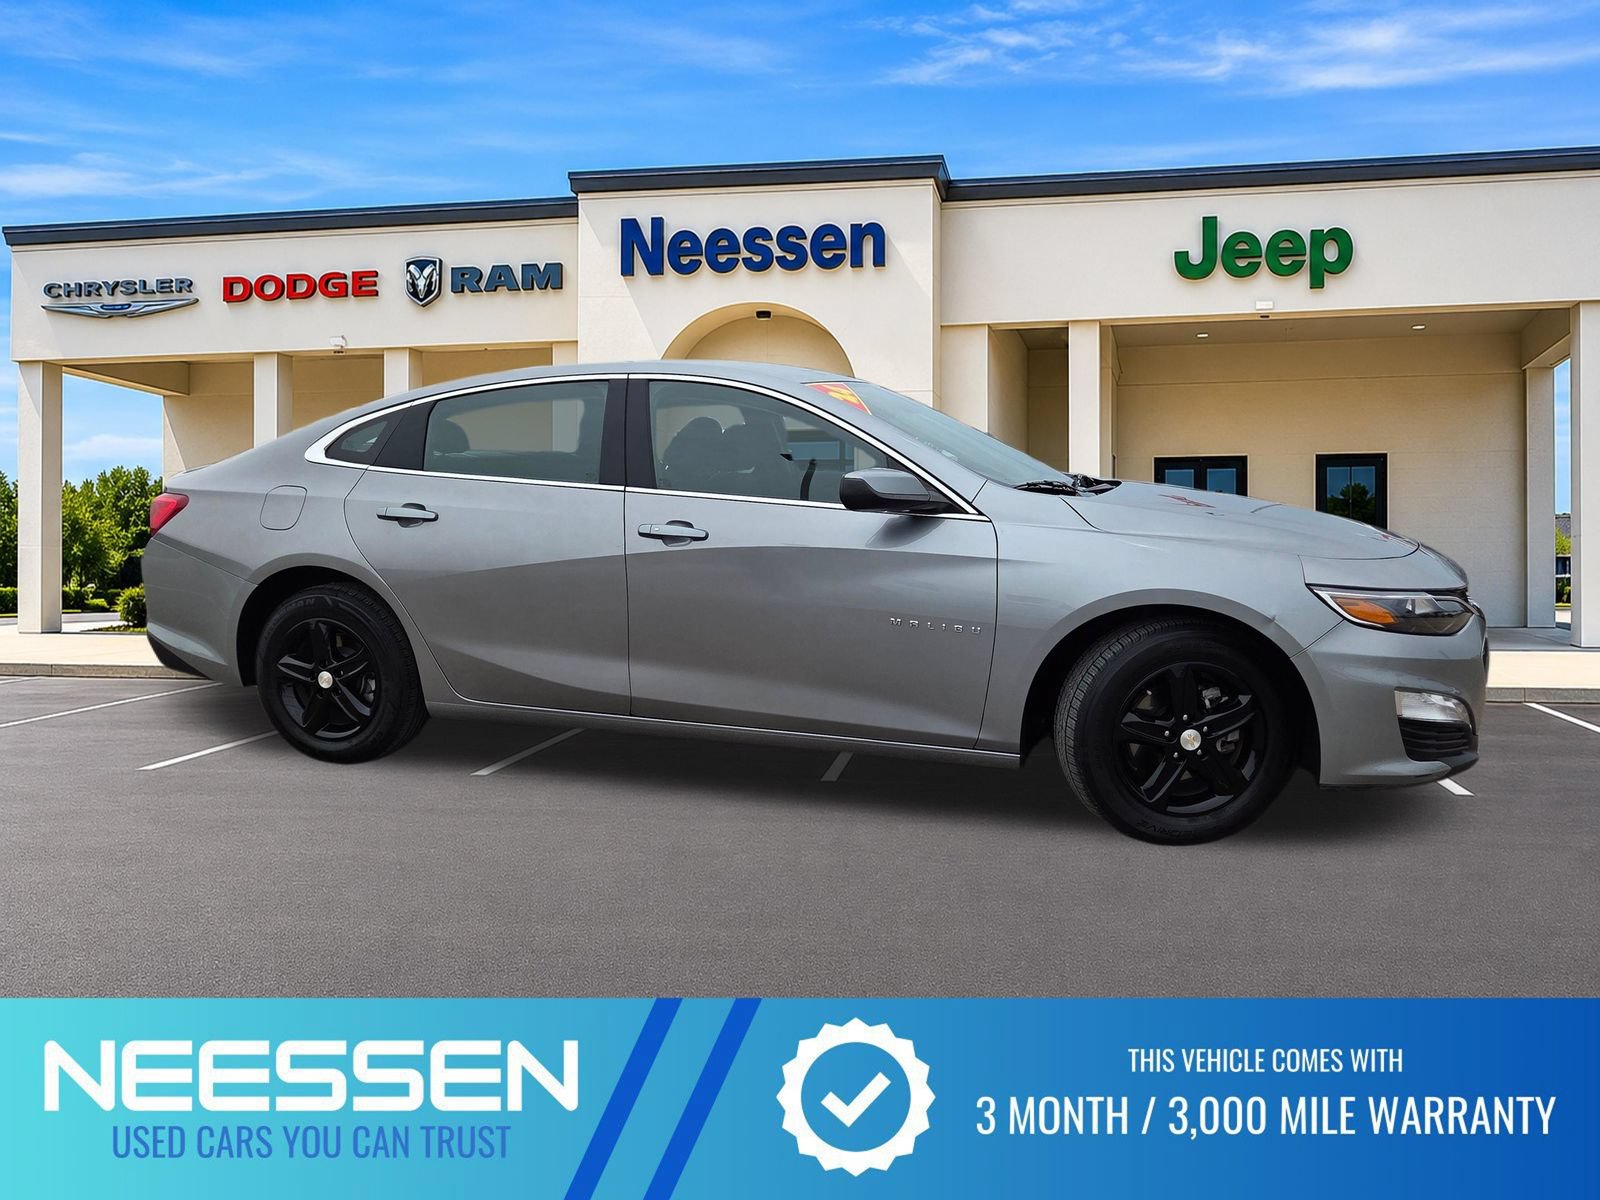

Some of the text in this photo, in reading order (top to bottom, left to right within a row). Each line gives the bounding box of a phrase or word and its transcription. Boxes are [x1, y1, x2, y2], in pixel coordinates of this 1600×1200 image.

[620, 216, 886, 277] Neessen
[1174, 215, 1354, 289] Jeep
[43, 277, 193, 299] CHRYSLER
[222, 270, 378, 303] DODGE
[450, 262, 564, 293] RAM
[890, 617, 981, 634] MALIBU
